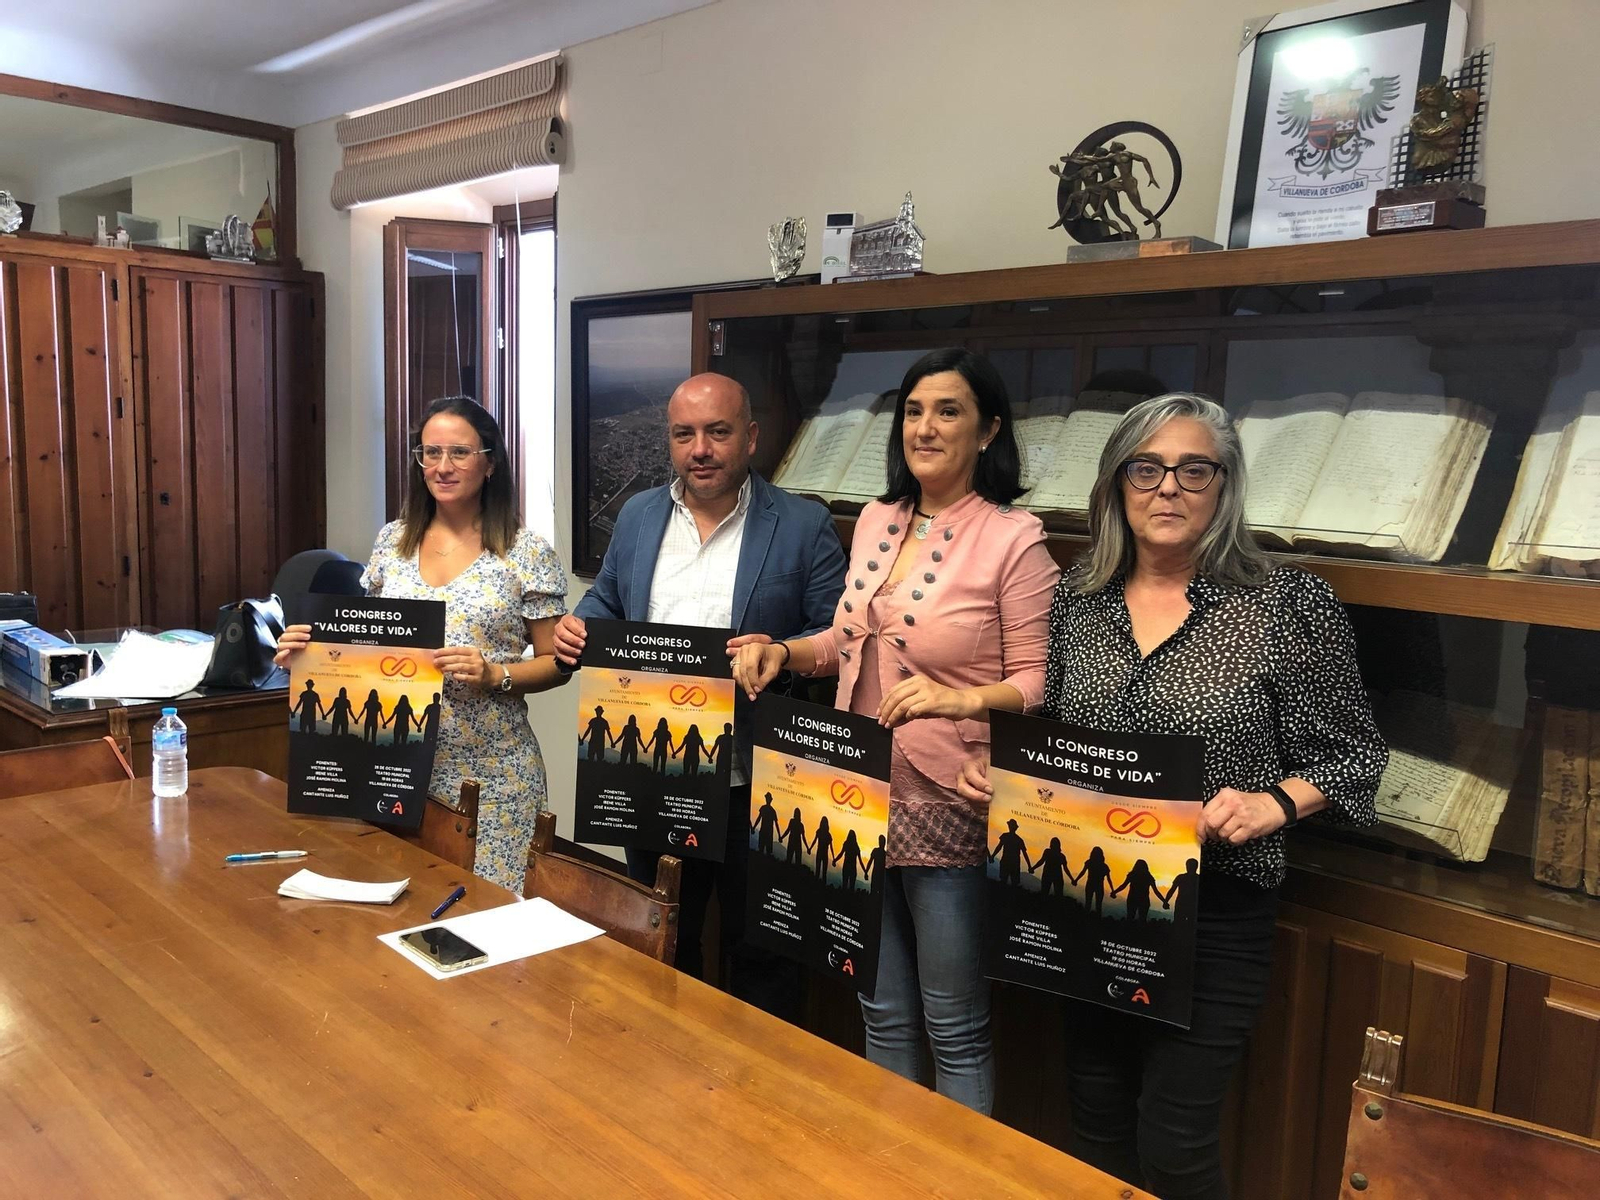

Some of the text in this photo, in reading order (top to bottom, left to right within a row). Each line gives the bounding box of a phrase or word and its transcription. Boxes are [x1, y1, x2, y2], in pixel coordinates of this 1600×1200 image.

[1283, 188, 1318, 196] VILLANUEVA
[1320, 187, 1328, 196] DE
[342, 609, 402, 620] CONGRESO
[314, 622, 417, 636] "VALORES DE VIDA"
[633, 635, 691, 648] CONGRESO
[606, 647, 707, 664] "VALORES DE VIDA"
[798, 717, 851, 738] CONGRESO
[774, 727, 866, 759] "VALORES DE VIDA"
[1056, 738, 1138, 762] CONGRESO
[804, 753, 830, 764] ORGANIZA
[1020, 748, 1162, 783] "VALORES DE VIDA"
[1067, 778, 1104, 792] ORGANIZA
[1025, 801, 1066, 815] AYUNTAMIENTO
[1011, 809, 1044, 822] VILLANUEVA
[1042, 944, 1062, 953] MOLINA
[1103, 947, 1155, 963] TEATRO MUNICIPAL
[1116, 944, 1142, 953] OCTUBRE
[1005, 954, 1033, 964] CANTANTE
[1024, 952, 1047, 961] AMENIZA
[1094, 957, 1126, 970] VILLANUEVA
[1136, 968, 1165, 977] CÓRDOBA
